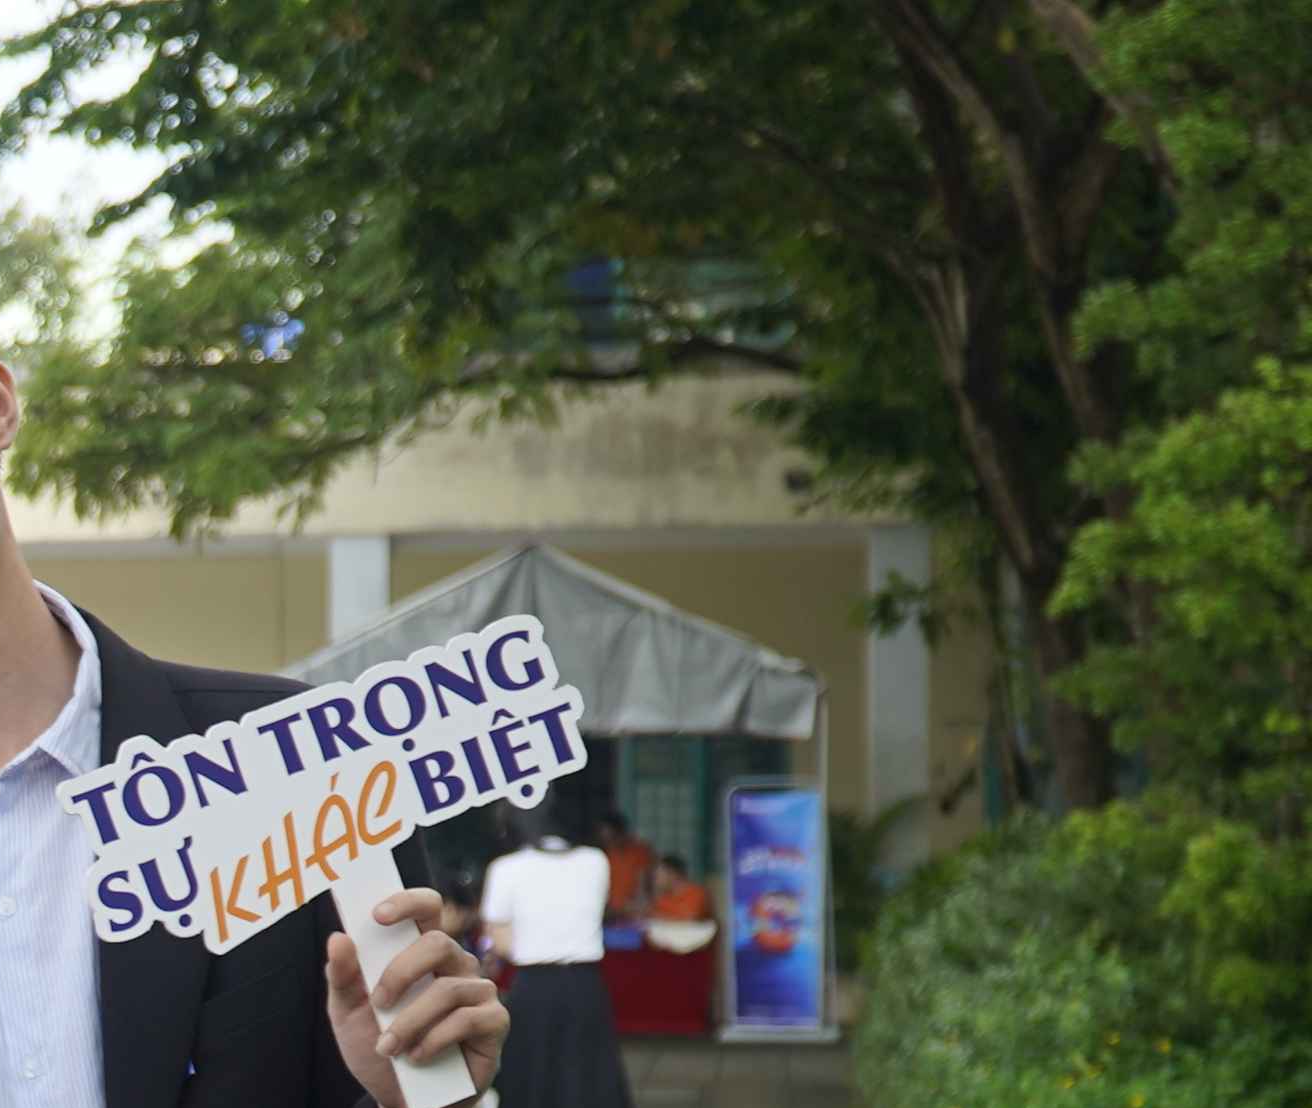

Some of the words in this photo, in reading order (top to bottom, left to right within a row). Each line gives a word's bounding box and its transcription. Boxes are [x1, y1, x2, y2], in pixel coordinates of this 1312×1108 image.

[71, 737, 248, 845] TÔN
[257, 629, 545, 777] TRỌNG
[96, 835, 199, 931] SỰ
[208, 760, 403, 942] KHÁC
[409, 702, 576, 813] BIỆT
